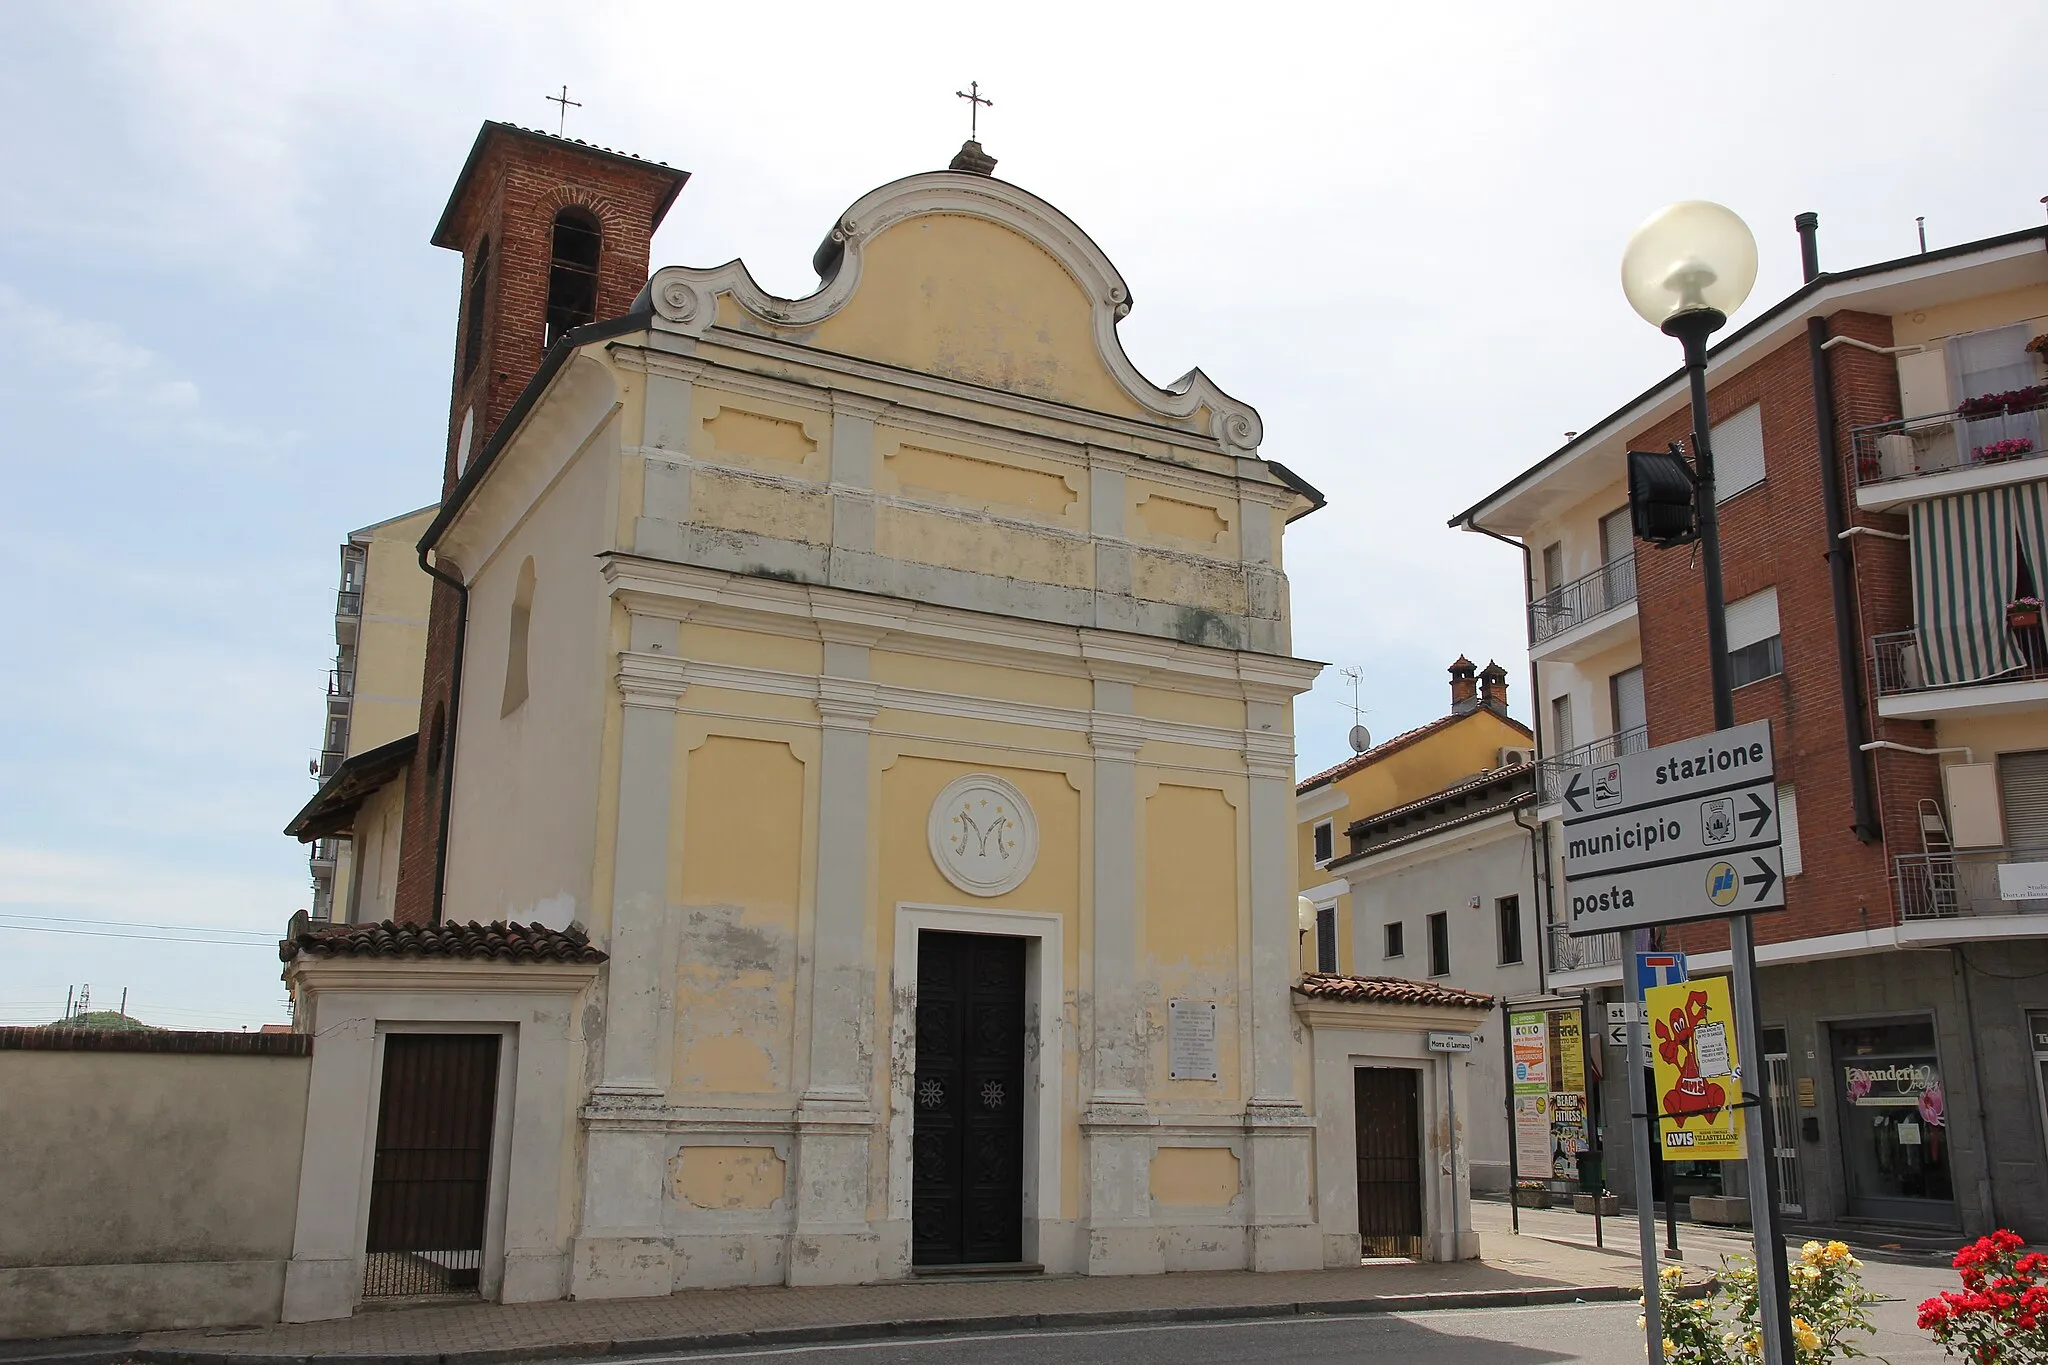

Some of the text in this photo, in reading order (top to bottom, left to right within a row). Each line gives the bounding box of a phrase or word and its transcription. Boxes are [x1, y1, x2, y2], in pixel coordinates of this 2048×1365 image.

[1655, 742, 1764, 785] stazione
[1569, 818, 1681, 859] municipio
[1572, 885, 1635, 921] posta
[1515, 1025, 1538, 1036] KOKO
[1431, 1040, 1445, 1048] Morra
[1844, 1064, 1925, 1083] Lavanderia
[1556, 1095, 1578, 1107] BEACH
[1555, 1110, 1581, 1122] FITNESS
[1667, 1132, 1694, 1146] AVIS
[1694, 1133, 1739, 1141] VILLASTELLONE
[1565, 1139, 1577, 1153] 39
